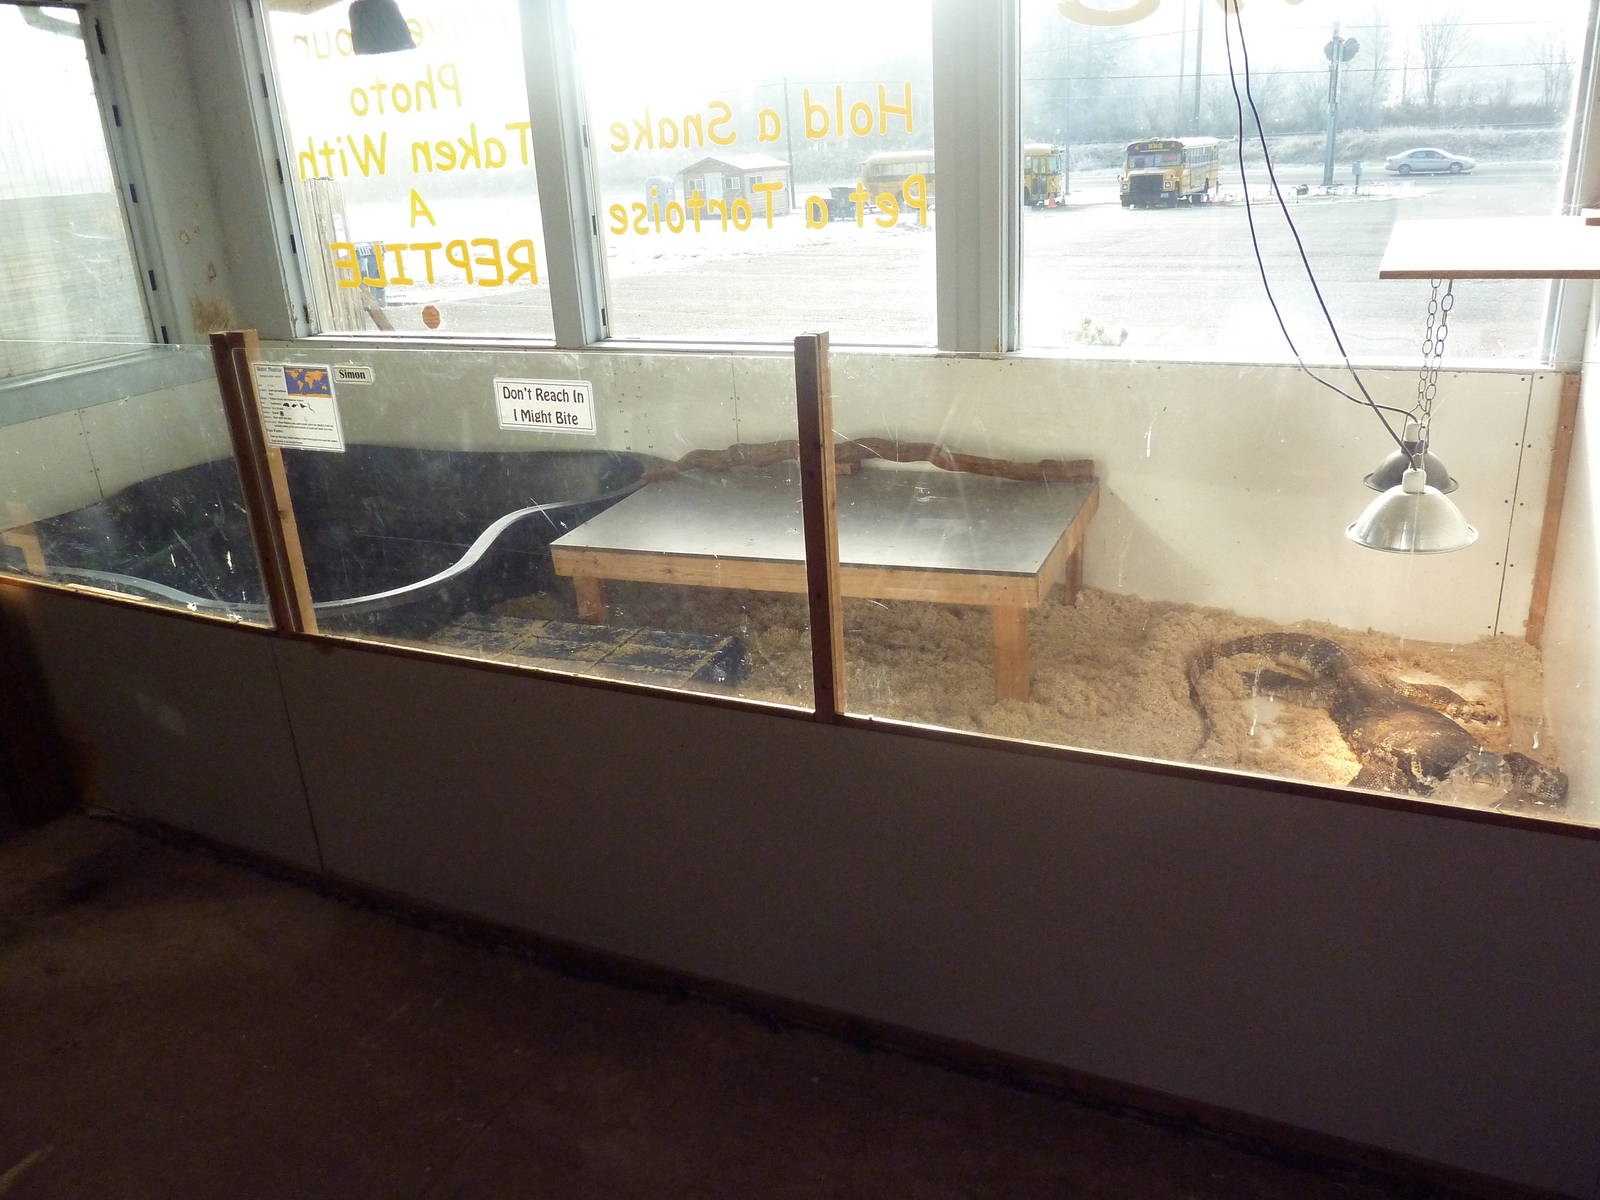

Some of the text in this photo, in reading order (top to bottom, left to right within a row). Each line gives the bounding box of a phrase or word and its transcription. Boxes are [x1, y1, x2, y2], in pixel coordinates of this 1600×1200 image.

[338, 368, 367, 381] Simon
[502, 386, 585, 404] Don't Reach In
[513, 408, 579, 426] I Might Bite
